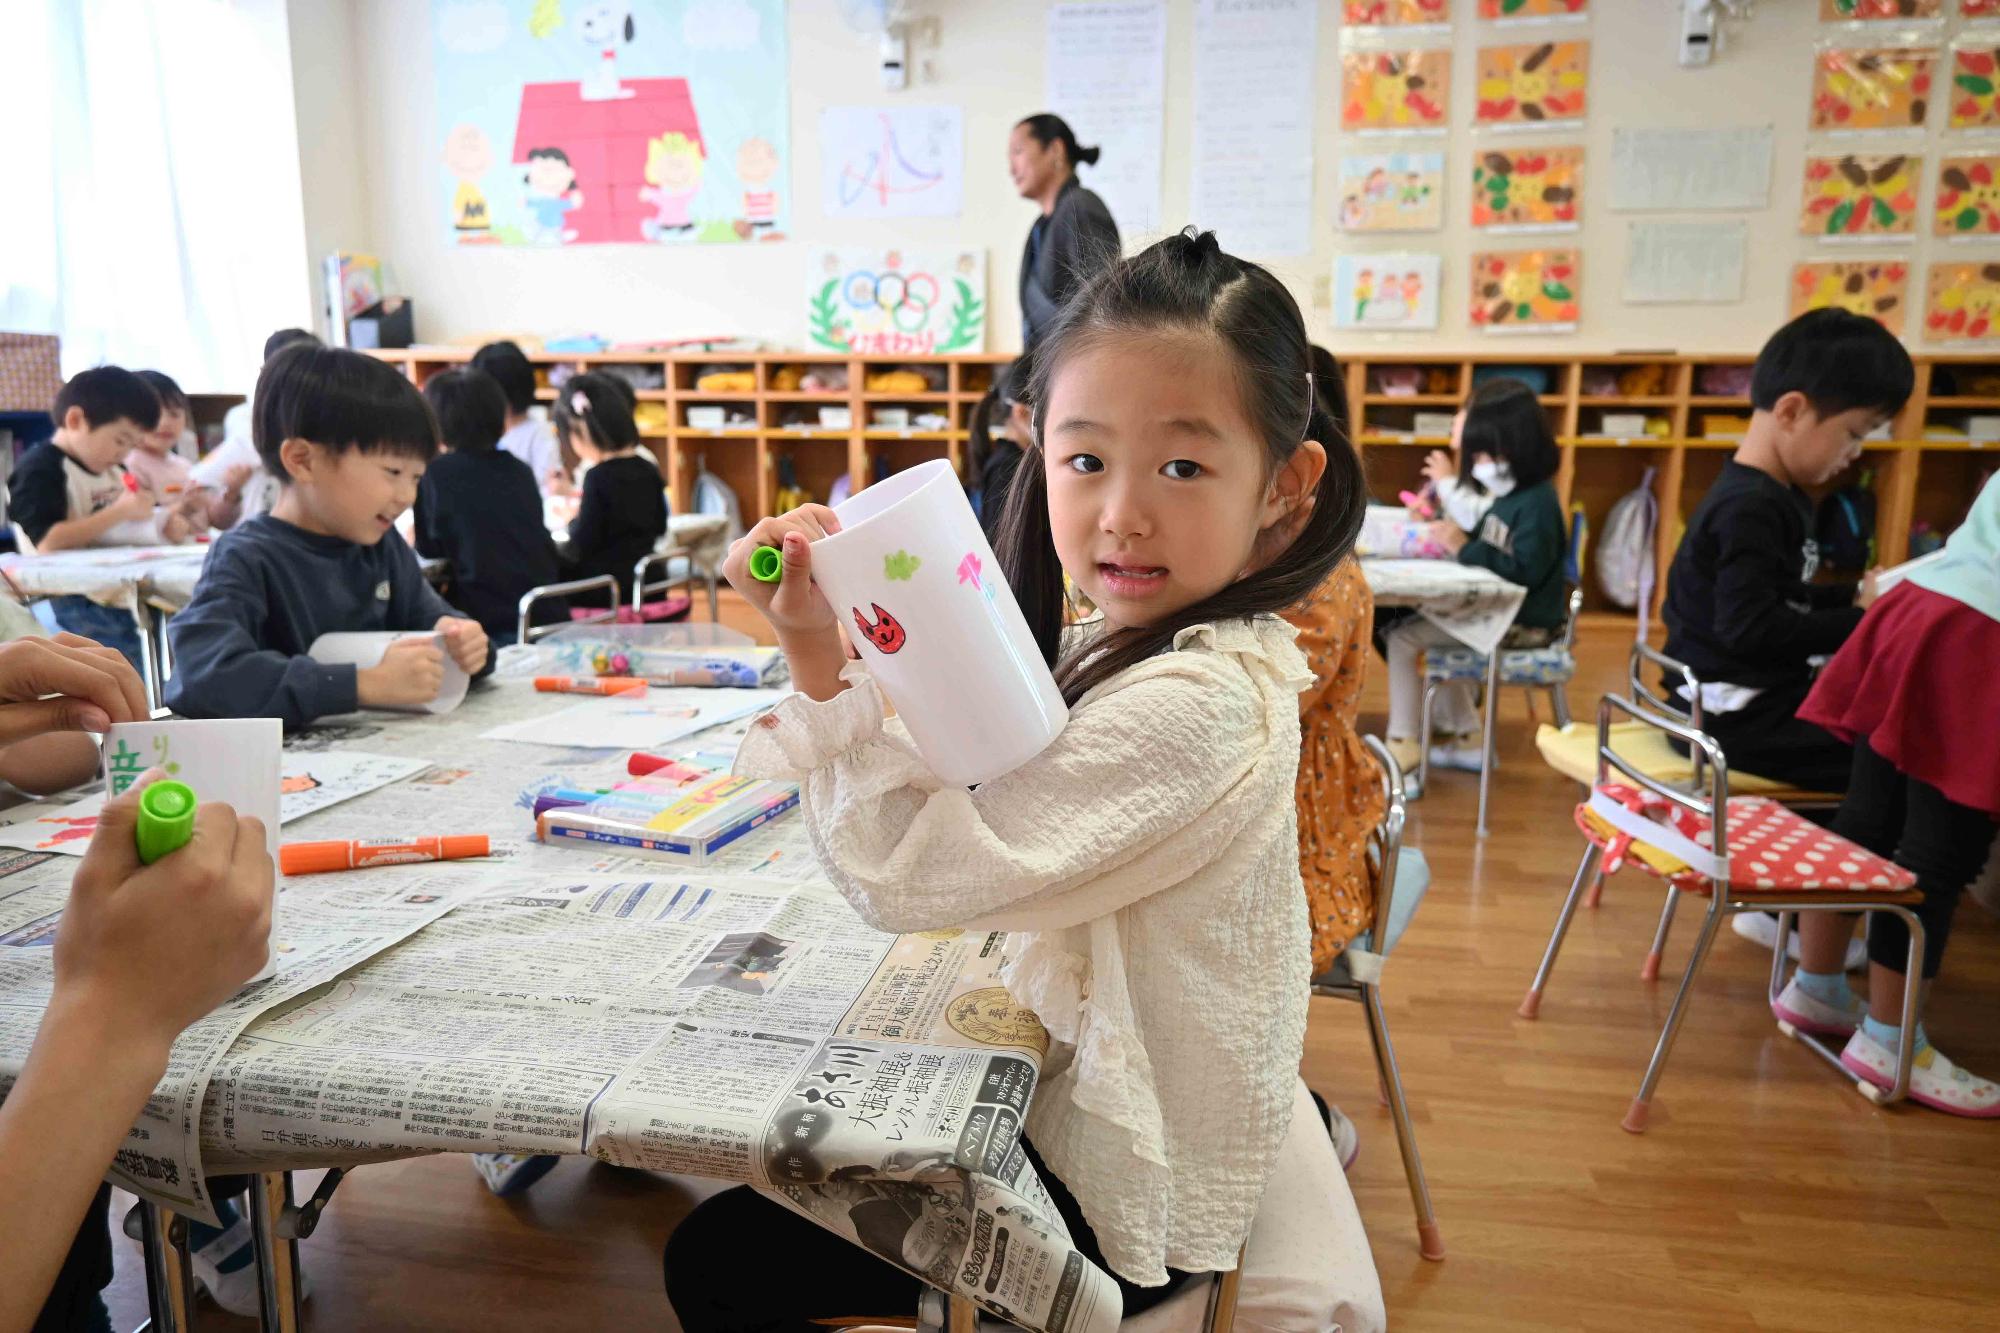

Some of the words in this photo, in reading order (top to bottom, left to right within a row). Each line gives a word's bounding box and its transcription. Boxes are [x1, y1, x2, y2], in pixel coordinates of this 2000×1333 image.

[847, 1051, 914, 1131] 大振袖展&
[886, 1054, 945, 1141] レンタル振袖展
[964, 1114, 987, 1158] ヘアメイク
